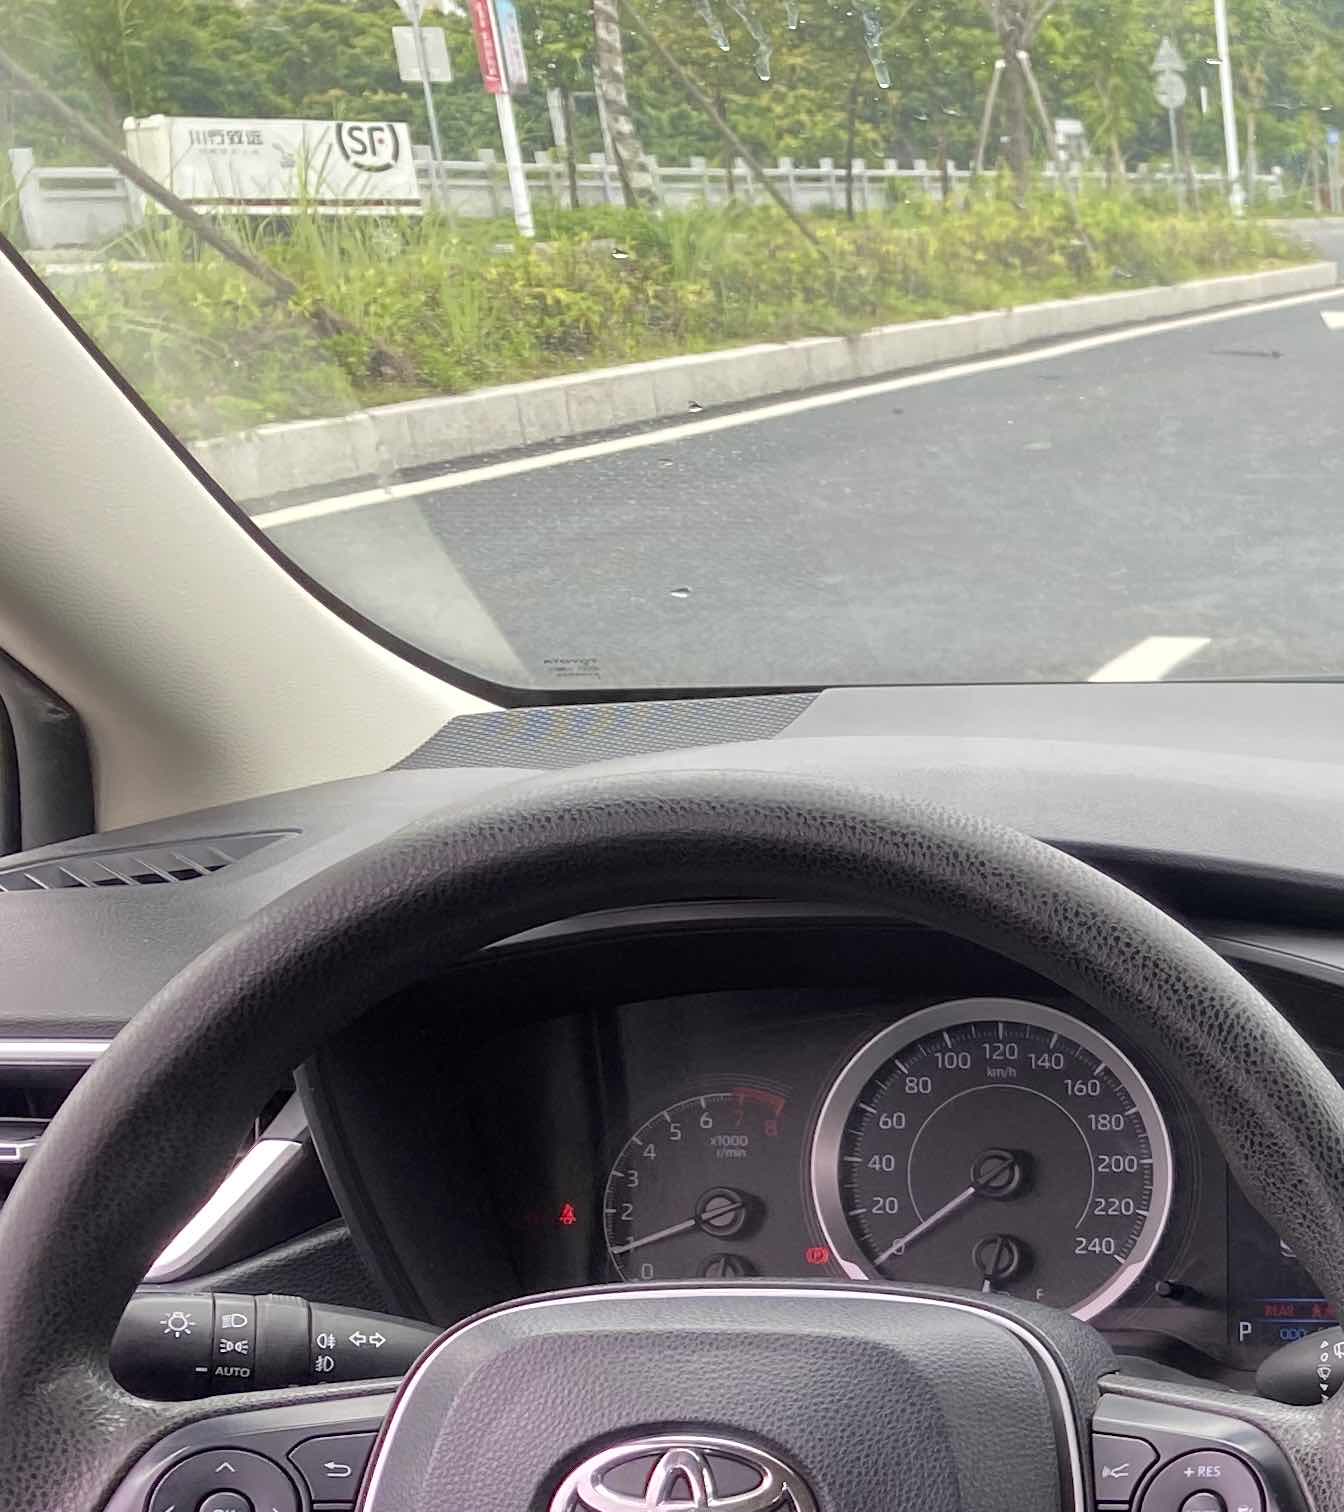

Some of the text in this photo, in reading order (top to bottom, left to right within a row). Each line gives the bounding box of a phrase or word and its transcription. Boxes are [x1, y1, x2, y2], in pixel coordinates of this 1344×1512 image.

[347, 125, 385, 156] SF
[984, 1043, 1018, 1060] 120
[935, 1052, 971, 1070] 100
[1030, 1053, 1064, 1070] 140
[986, 1067, 1016, 1078] km/h
[905, 1077, 932, 1094] 80
[1064, 1080, 1100, 1096] 160
[700, 1113, 713, 1129] 6
[879, 1113, 906, 1129] 60
[1088, 1114, 1124, 1131] 180
[669, 1123, 681, 1140] 5
[643, 1144, 656, 1160] 4
[868, 1155, 895, 1171] 40
[1098, 1155, 1137, 1172] 200
[628, 1171, 639, 1187] 3
[621, 1204, 633, 1221] 2
[871, 1197, 898, 1214] 20
[1094, 1199, 1134, 1216] 220
[1075, 1238, 1115, 1255] 240
[641, 1263, 654, 1280] 0
[1239, 1321, 1252, 1342] P
[214, 1367, 250, 1378] AUTO
[1198, 1466, 1221, 1478] RES
